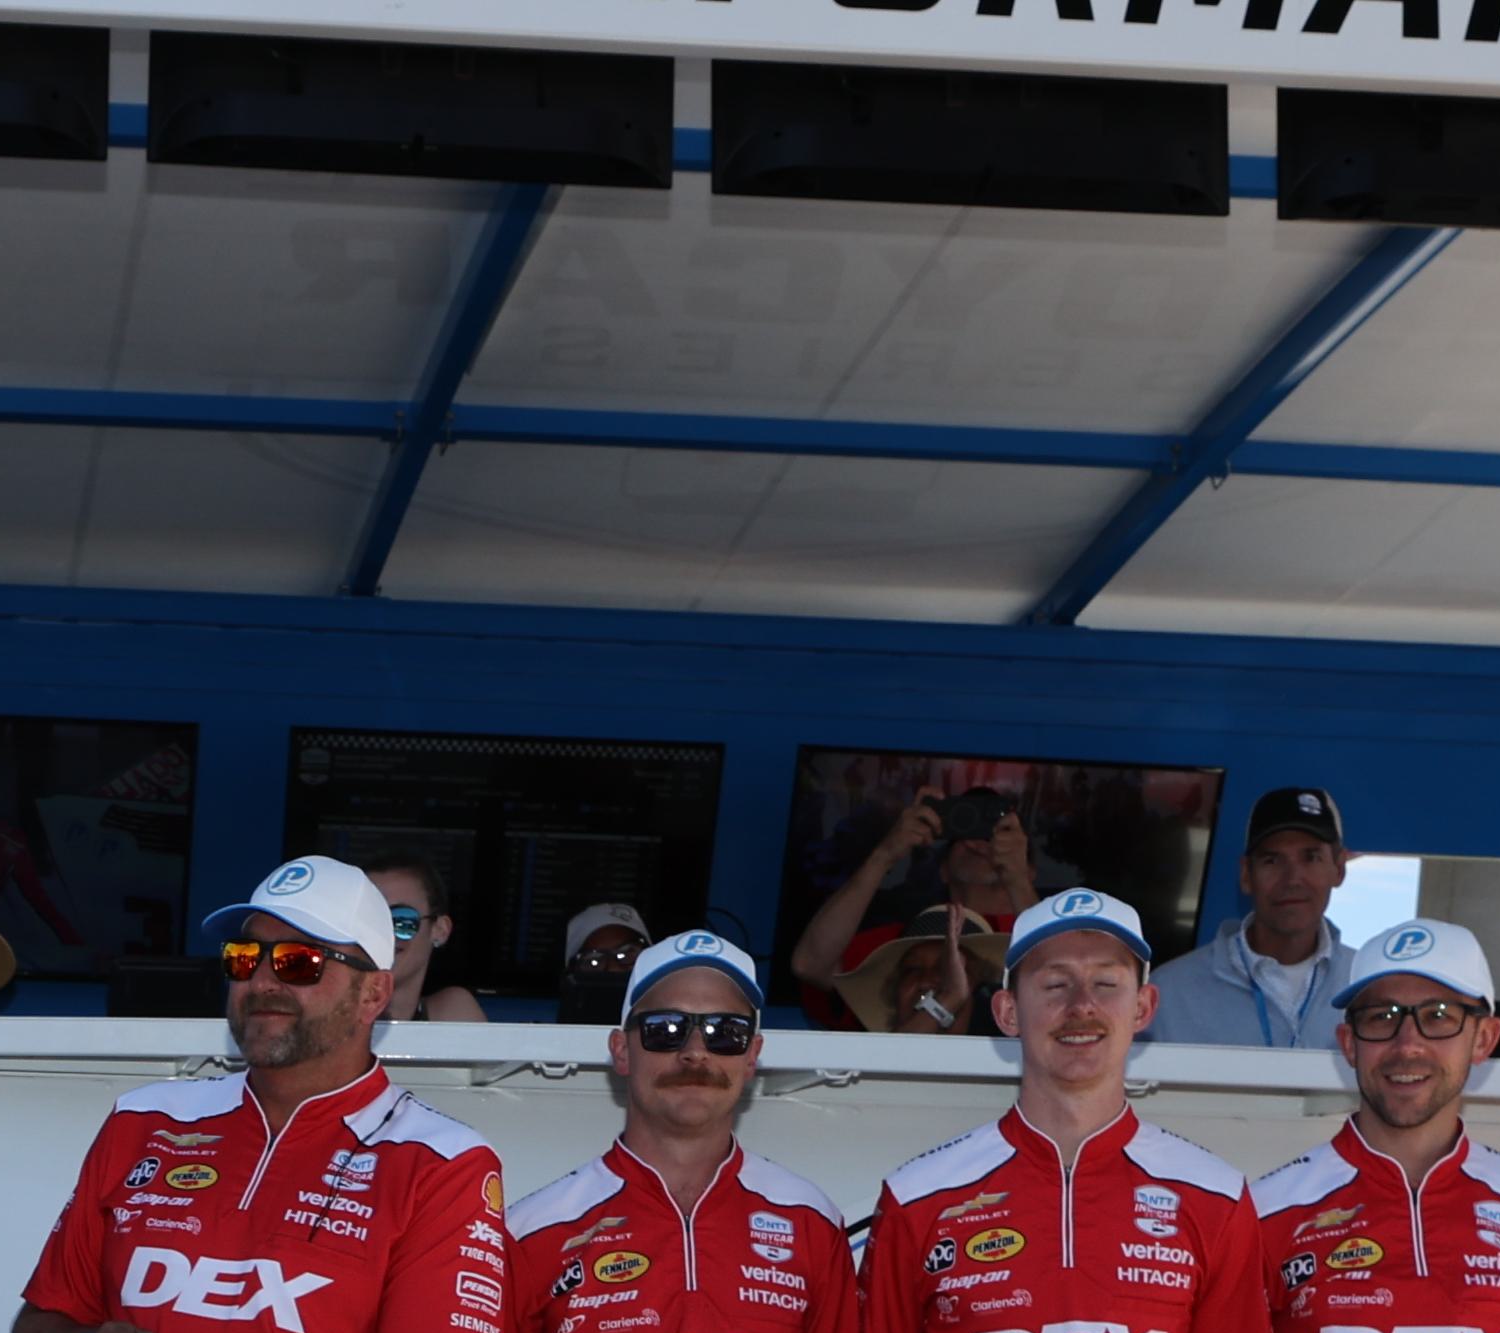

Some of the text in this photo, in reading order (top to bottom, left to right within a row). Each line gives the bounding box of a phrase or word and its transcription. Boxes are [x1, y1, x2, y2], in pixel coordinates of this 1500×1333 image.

[298, 1190, 374, 1219] verizon
[284, 1209, 368, 1242] HITACHI
[1120, 1242, 1195, 1266] verizon
[599, 1258, 645, 1276] PENNZOIL
[740, 1265, 805, 1291] verizon
[1328, 1293, 1385, 1305] Clarience
